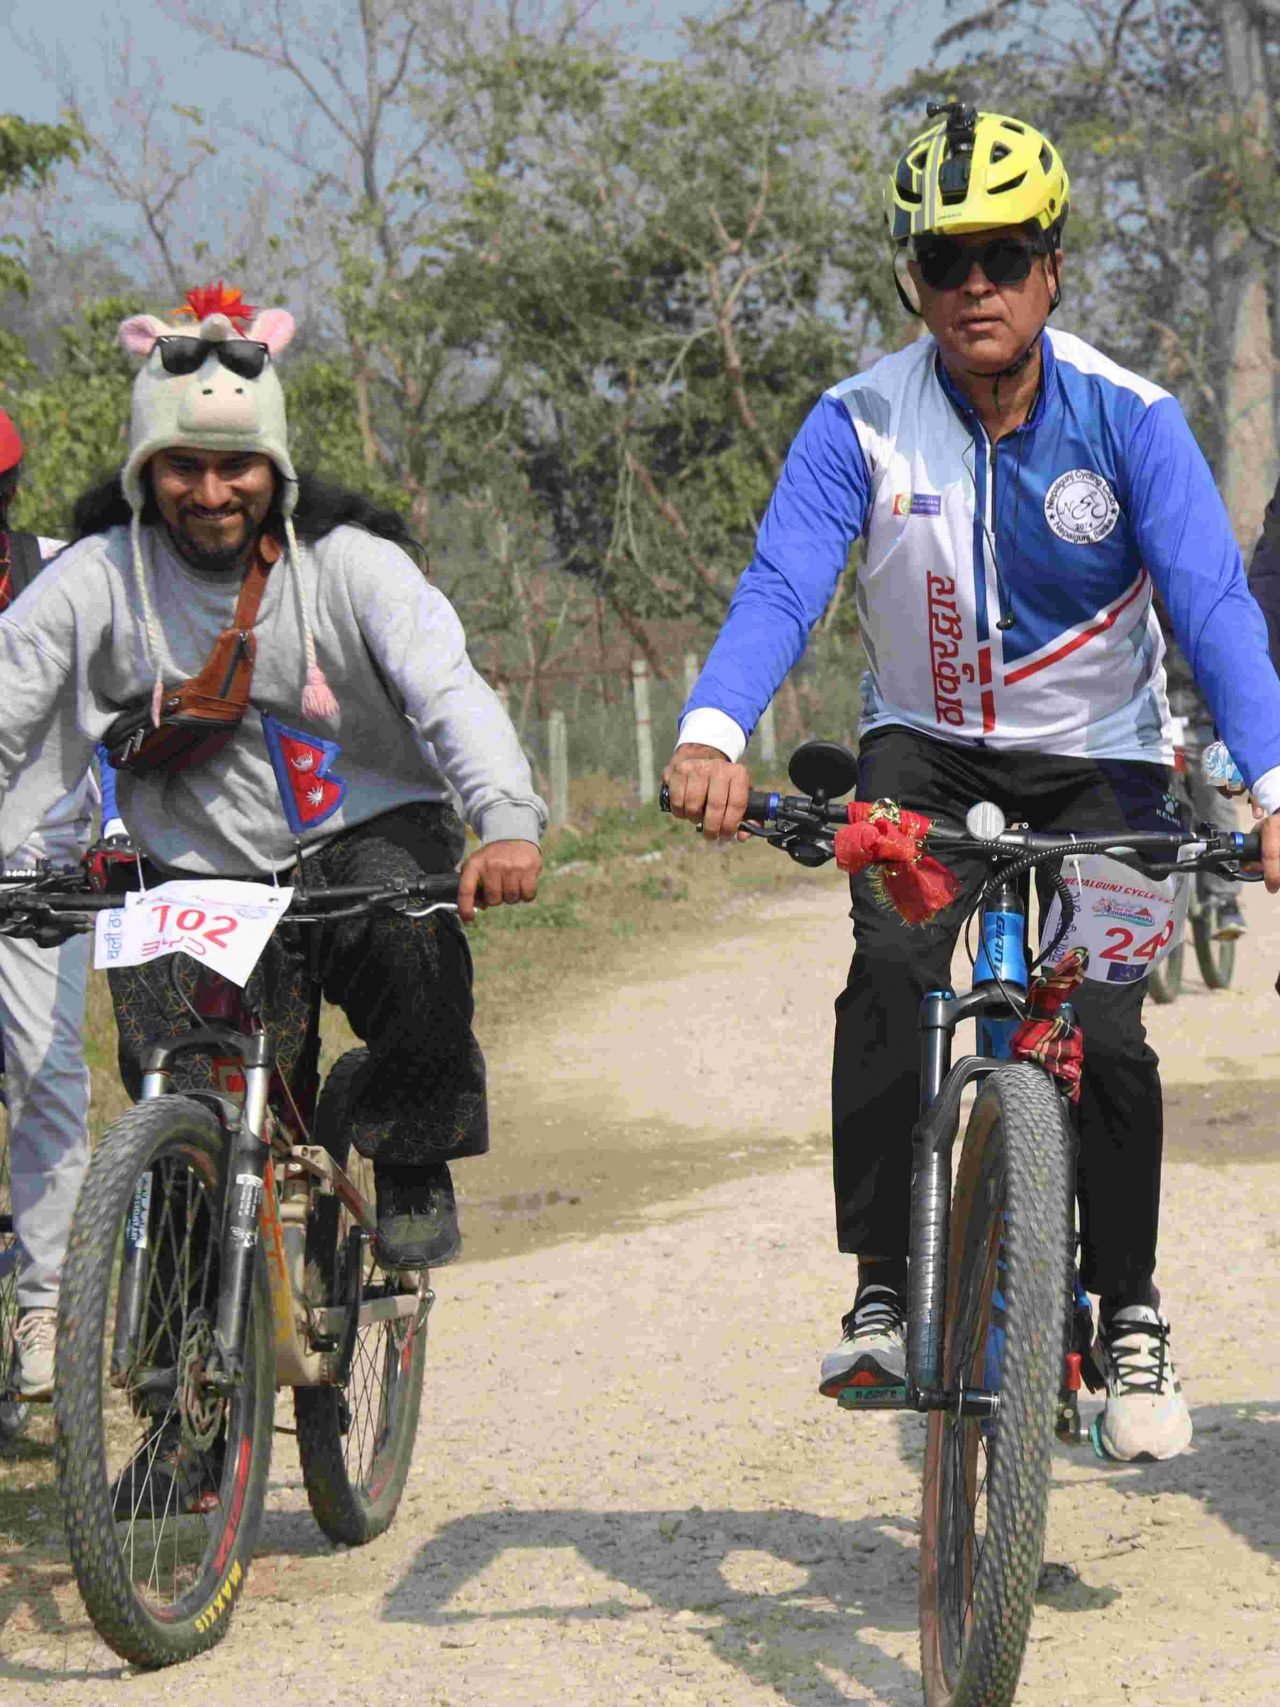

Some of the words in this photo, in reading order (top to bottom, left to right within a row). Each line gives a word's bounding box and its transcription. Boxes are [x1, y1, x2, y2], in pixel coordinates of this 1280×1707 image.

[1075, 470, 1102, 487] Cycling
[152, 905, 238, 949] 102
[194, 1559, 242, 1633] MAXXIS
